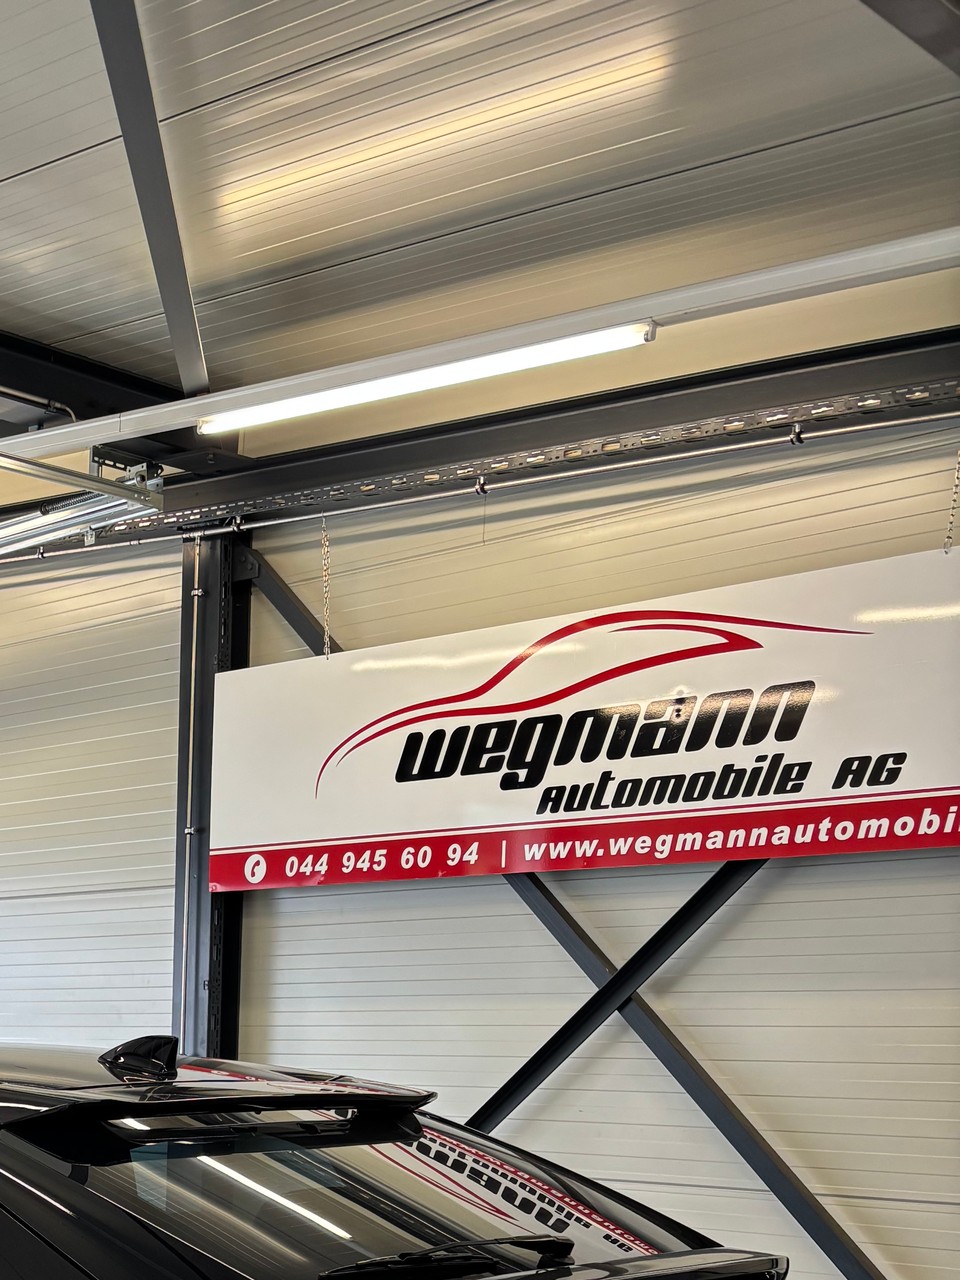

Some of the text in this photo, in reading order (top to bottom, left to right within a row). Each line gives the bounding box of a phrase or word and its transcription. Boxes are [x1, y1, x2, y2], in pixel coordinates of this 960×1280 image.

[395, 680, 818, 791] wegmann
[831, 752, 908, 790] AG
[284, 805, 960, 878] 044 945 60 94 www.wegmannautomobi
